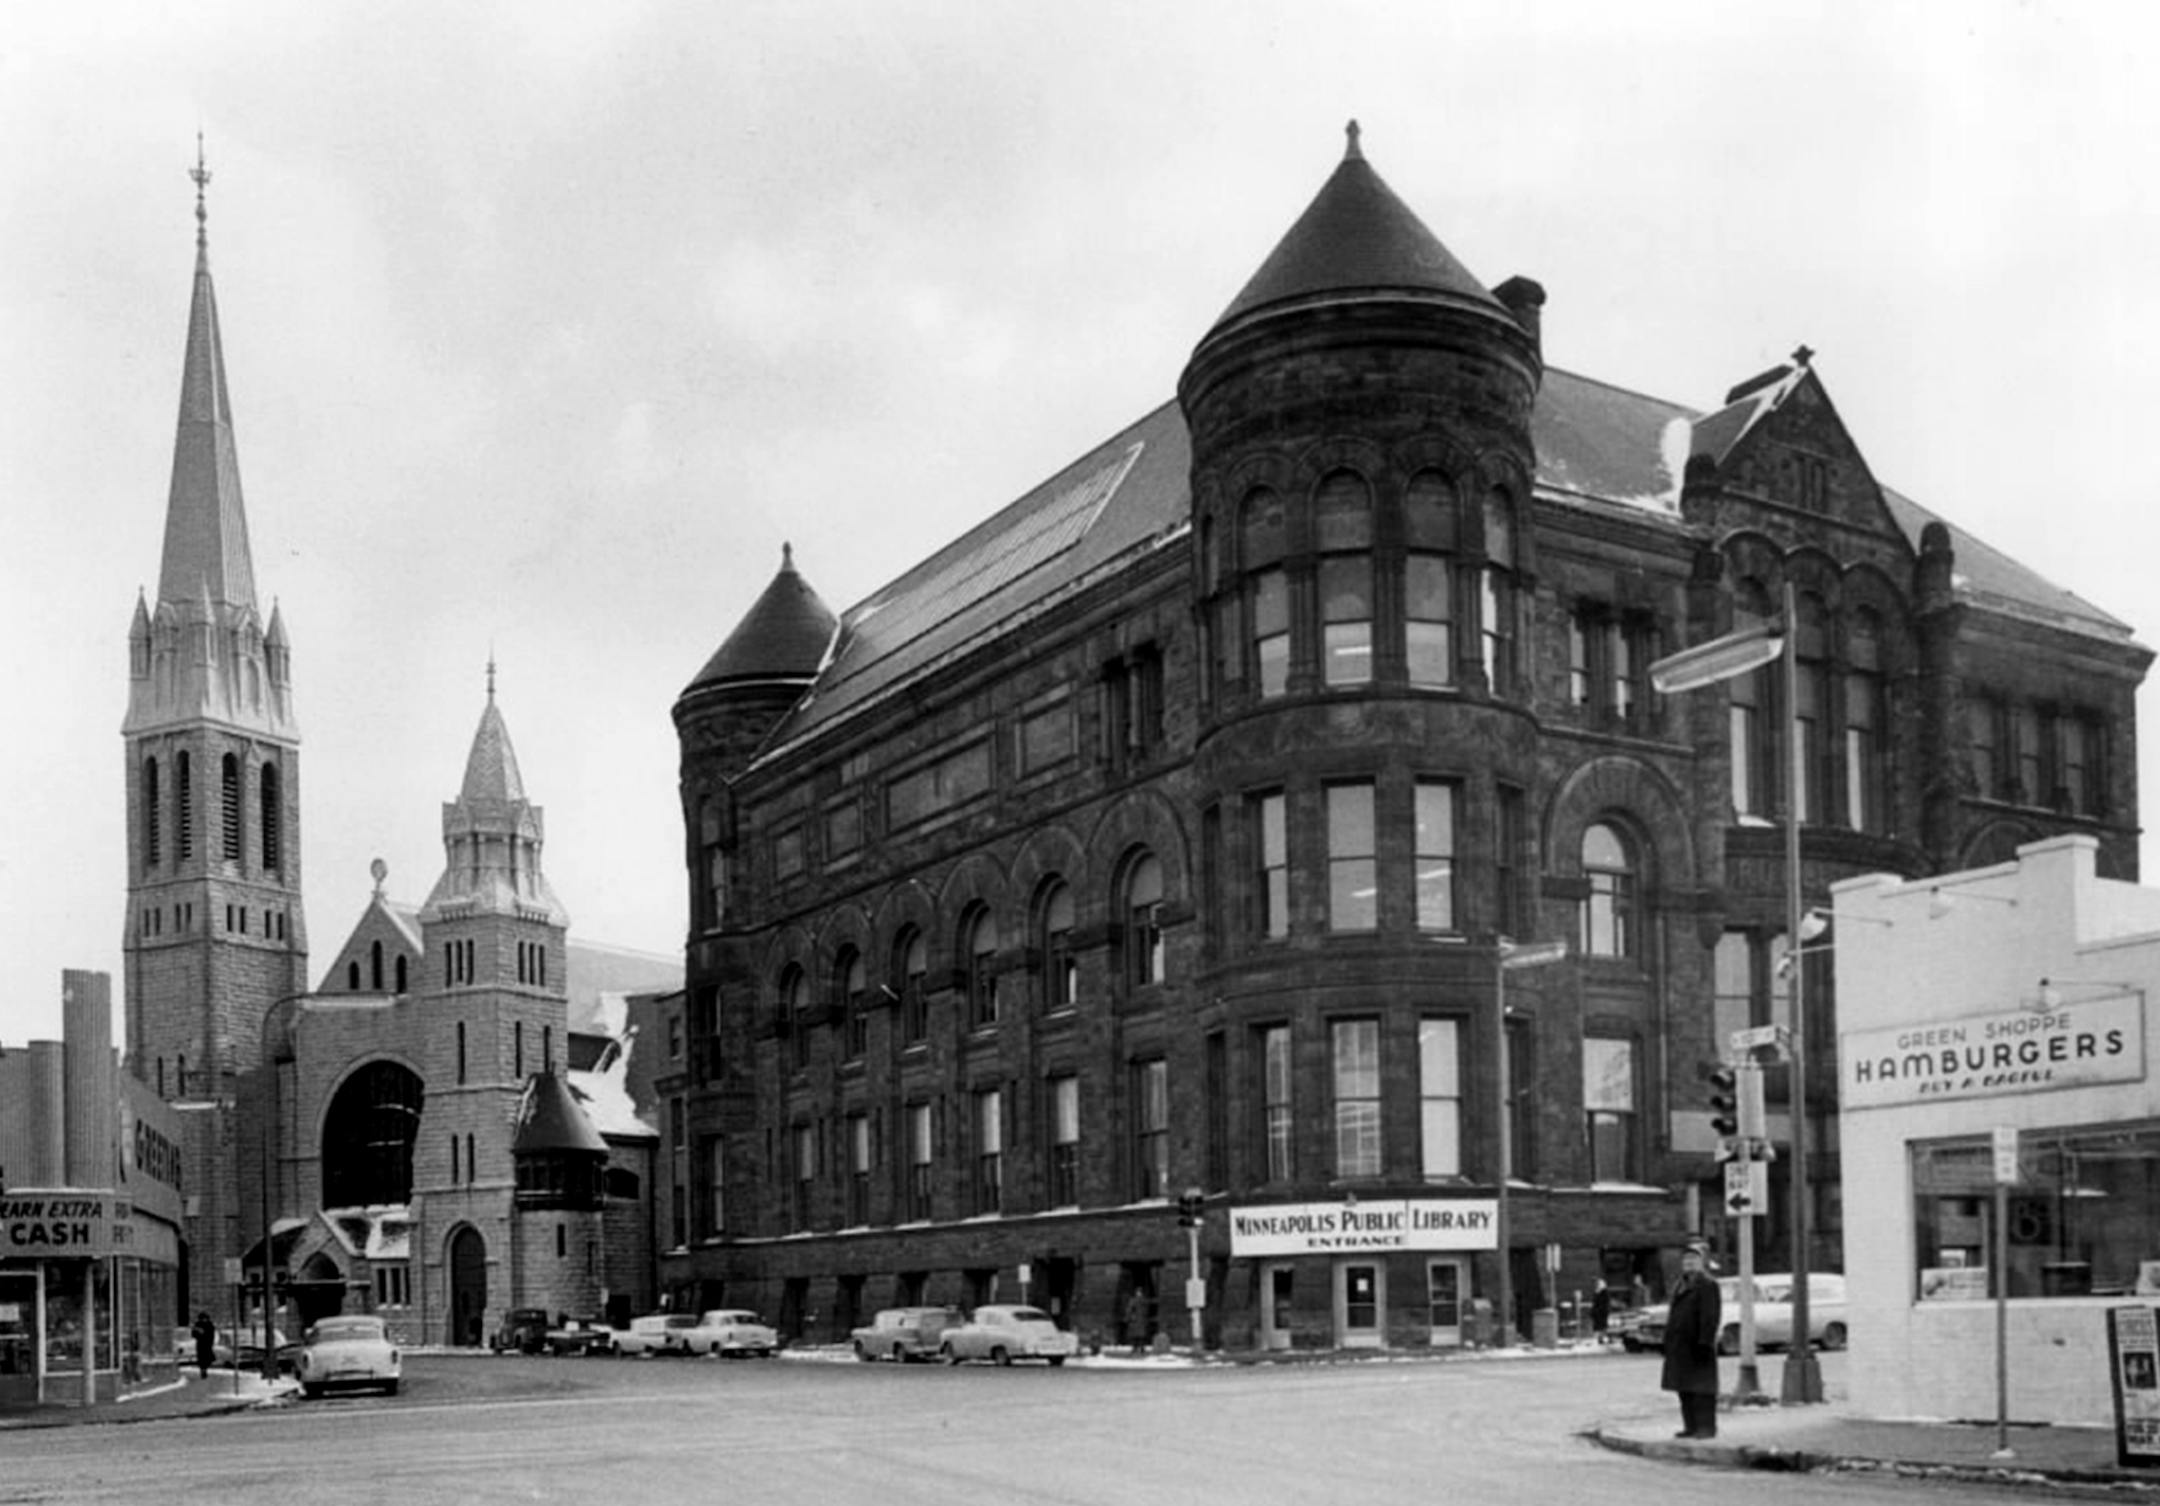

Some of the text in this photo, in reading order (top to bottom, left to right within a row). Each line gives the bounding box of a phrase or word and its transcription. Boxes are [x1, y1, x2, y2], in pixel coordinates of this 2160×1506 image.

[1897, 1012, 2071, 1050] GREEN SHOPPE
[1856, 1030, 2124, 1083] HAMBURGERS
[0, 1201, 45, 1219] EARN
[48, 1201, 103, 1219] EXTRA
[1235, 1207, 1493, 1236] MINNEAPOLIS PUBLIC LIBRARY
[10, 1222, 90, 1245] CASH
[1307, 1235, 1402, 1248] ENTRANCE
